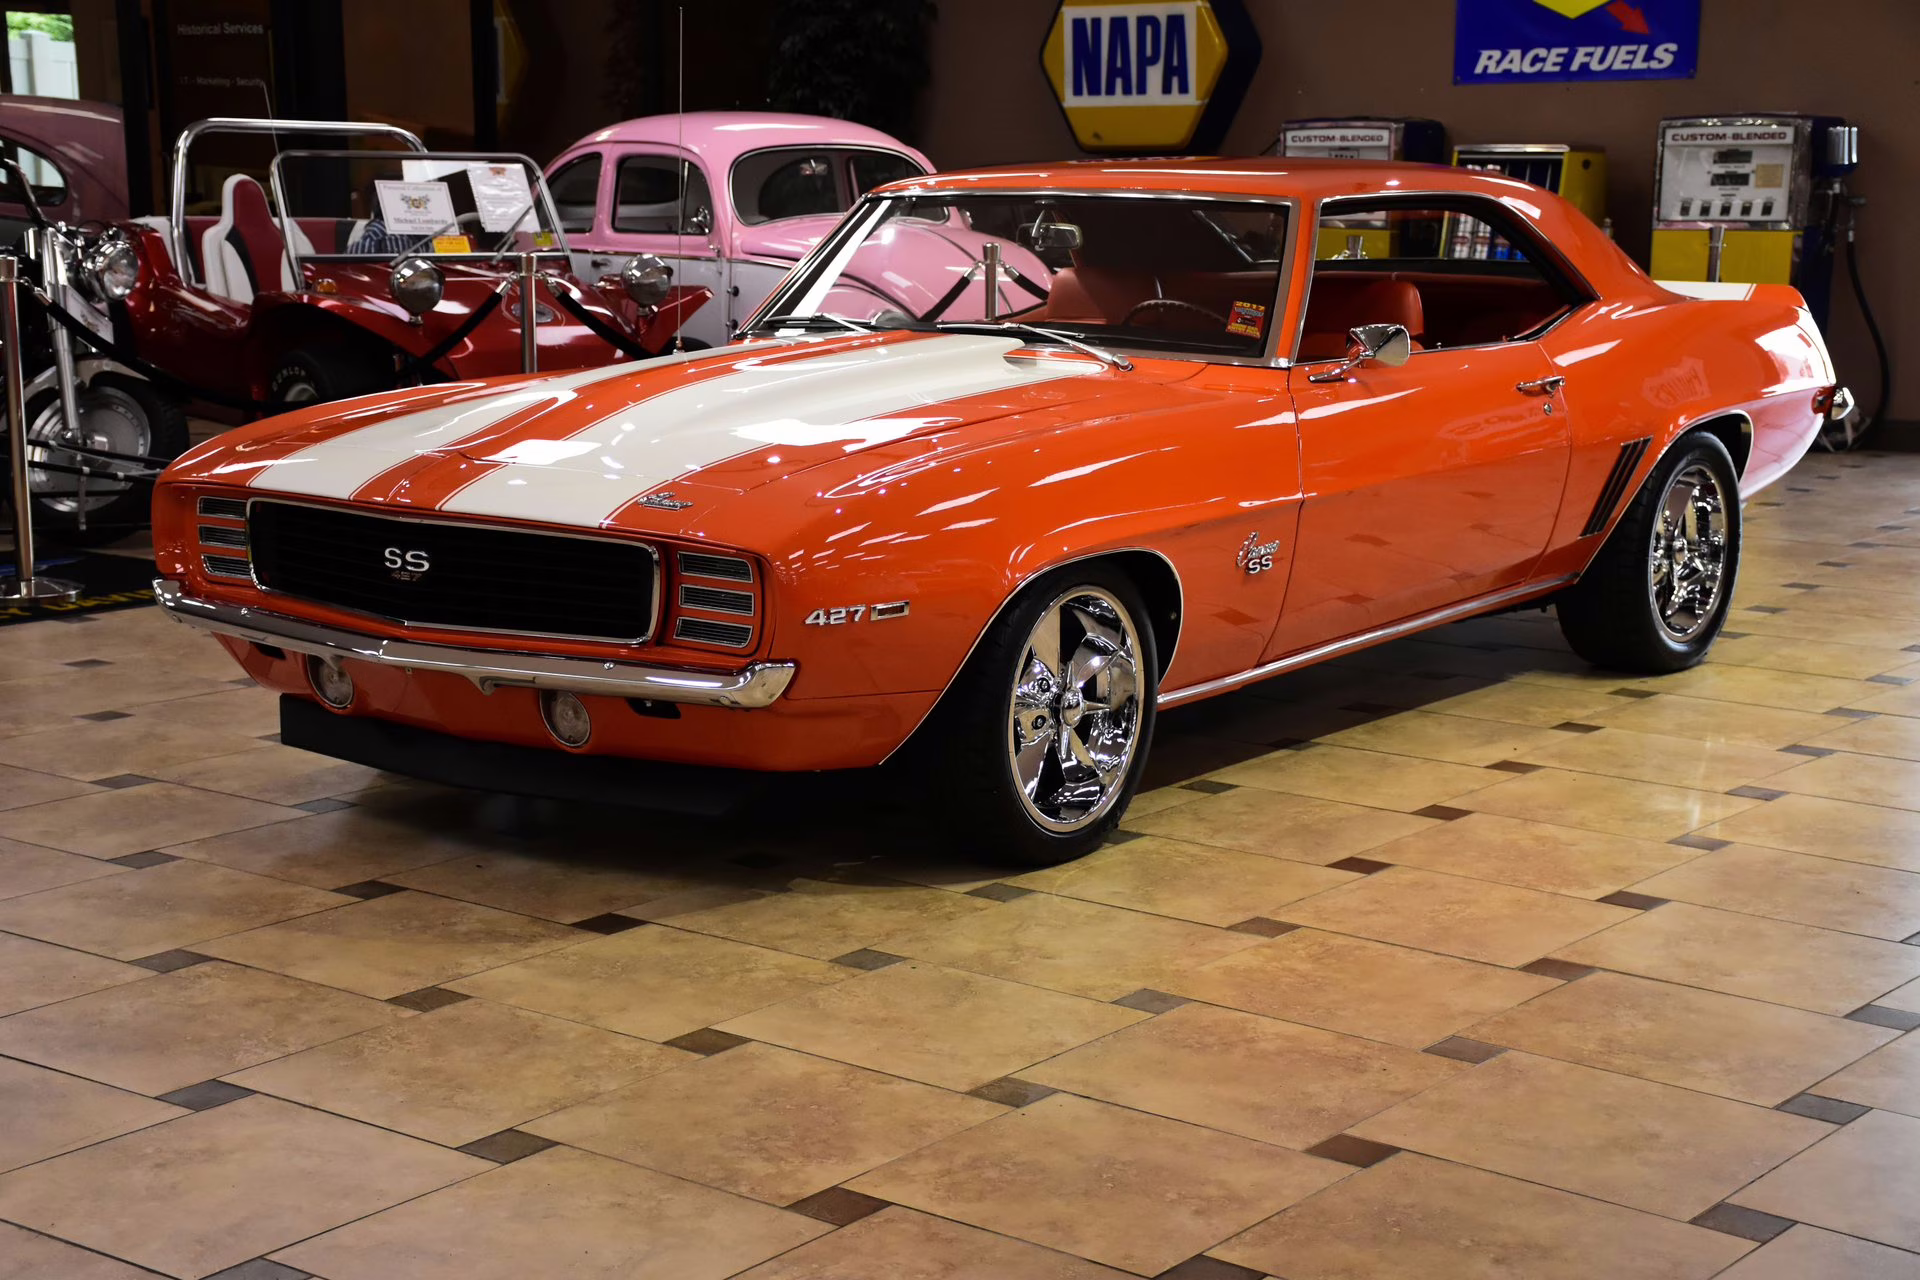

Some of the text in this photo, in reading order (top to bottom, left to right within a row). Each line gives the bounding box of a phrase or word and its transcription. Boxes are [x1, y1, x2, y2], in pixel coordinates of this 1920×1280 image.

[177, 22, 264, 35] Historical Services
[1072, 14, 1189, 97] NAPA
[1474, 43, 1678, 75] RACE FUELS
[1235, 301, 1265, 311] 2017
[384, 547, 430, 572] SS
[1248, 555, 1273, 574] SS
[804, 604, 867, 626] 427
